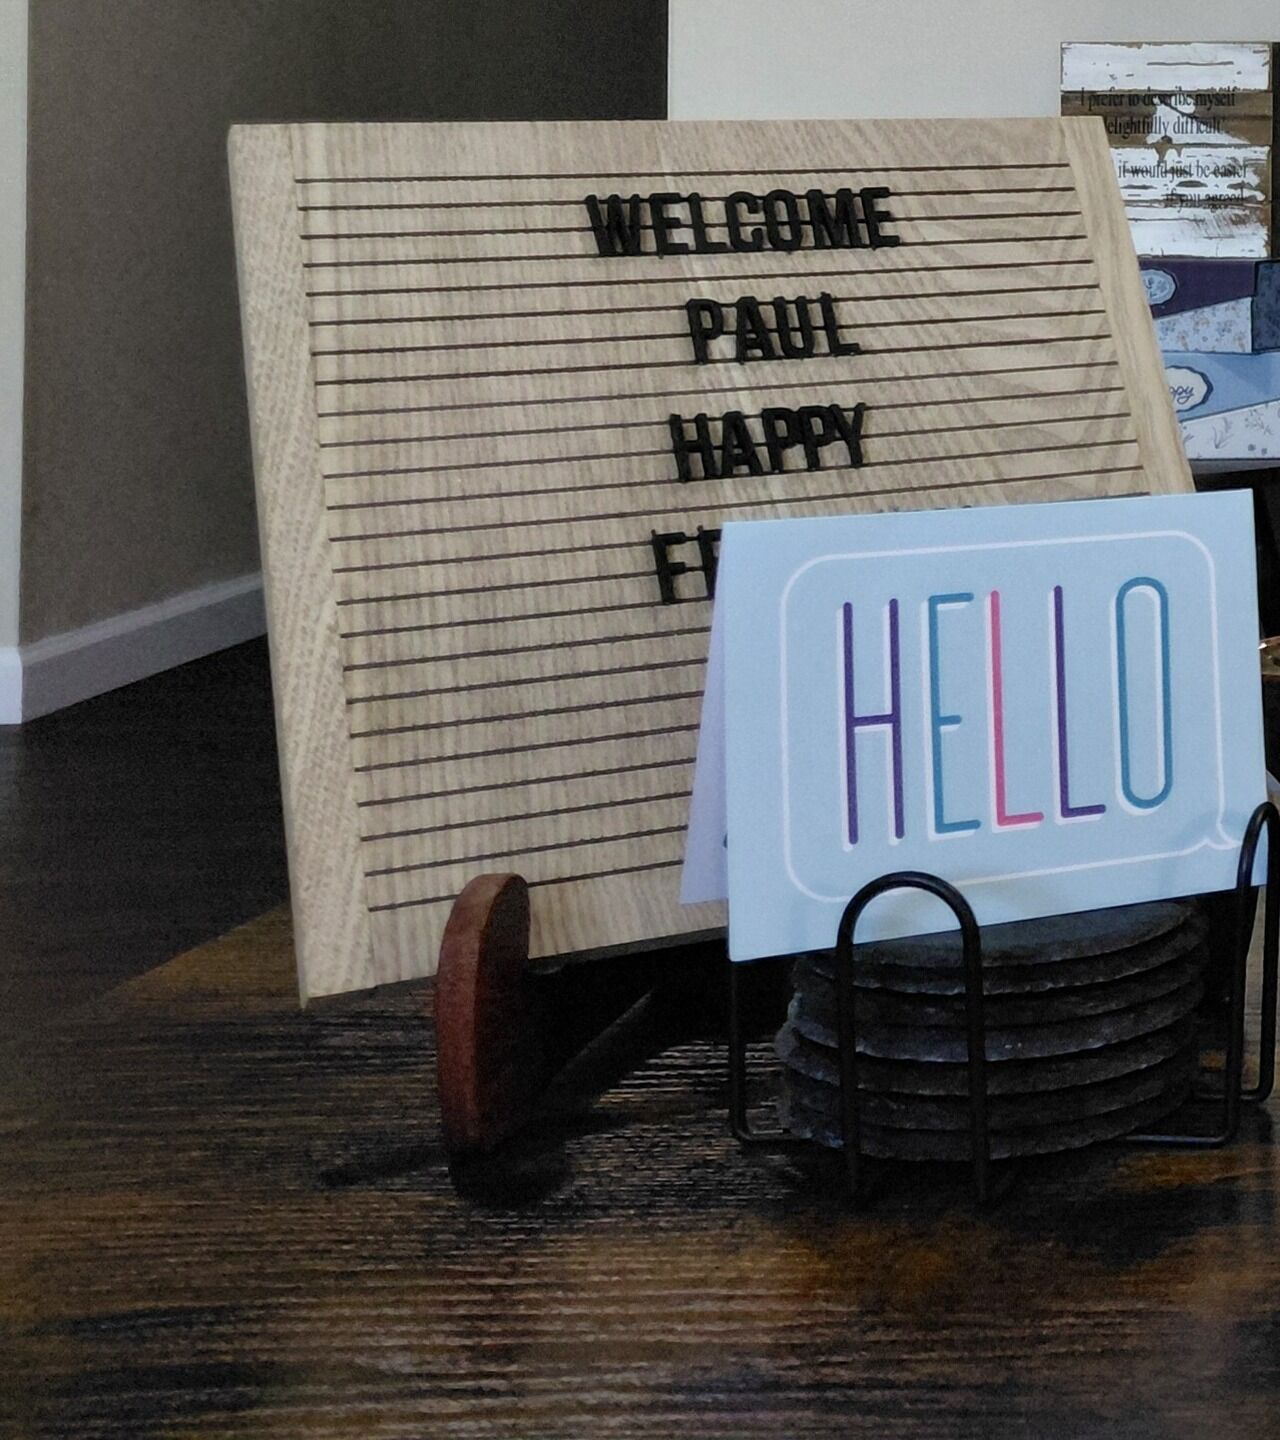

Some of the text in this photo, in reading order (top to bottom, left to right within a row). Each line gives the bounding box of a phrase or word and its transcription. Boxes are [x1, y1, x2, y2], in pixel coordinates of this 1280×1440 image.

[1088, 86, 1126, 111] prefer
[1127, 90, 1140, 106] to
[1194, 86, 1238, 111] myself
[1130, 160, 1168, 179] would
[1169, 160, 1193, 182] just
[1195, 159, 1210, 178] be
[1211, 160, 1248, 178] easier
[1177, 194, 1200, 213] you
[584, 187, 900, 258] WELCOME
[685, 292, 862, 365] PAUL
[668, 401, 867, 483] HAPPY
[838, 576, 1174, 852] HELLO
